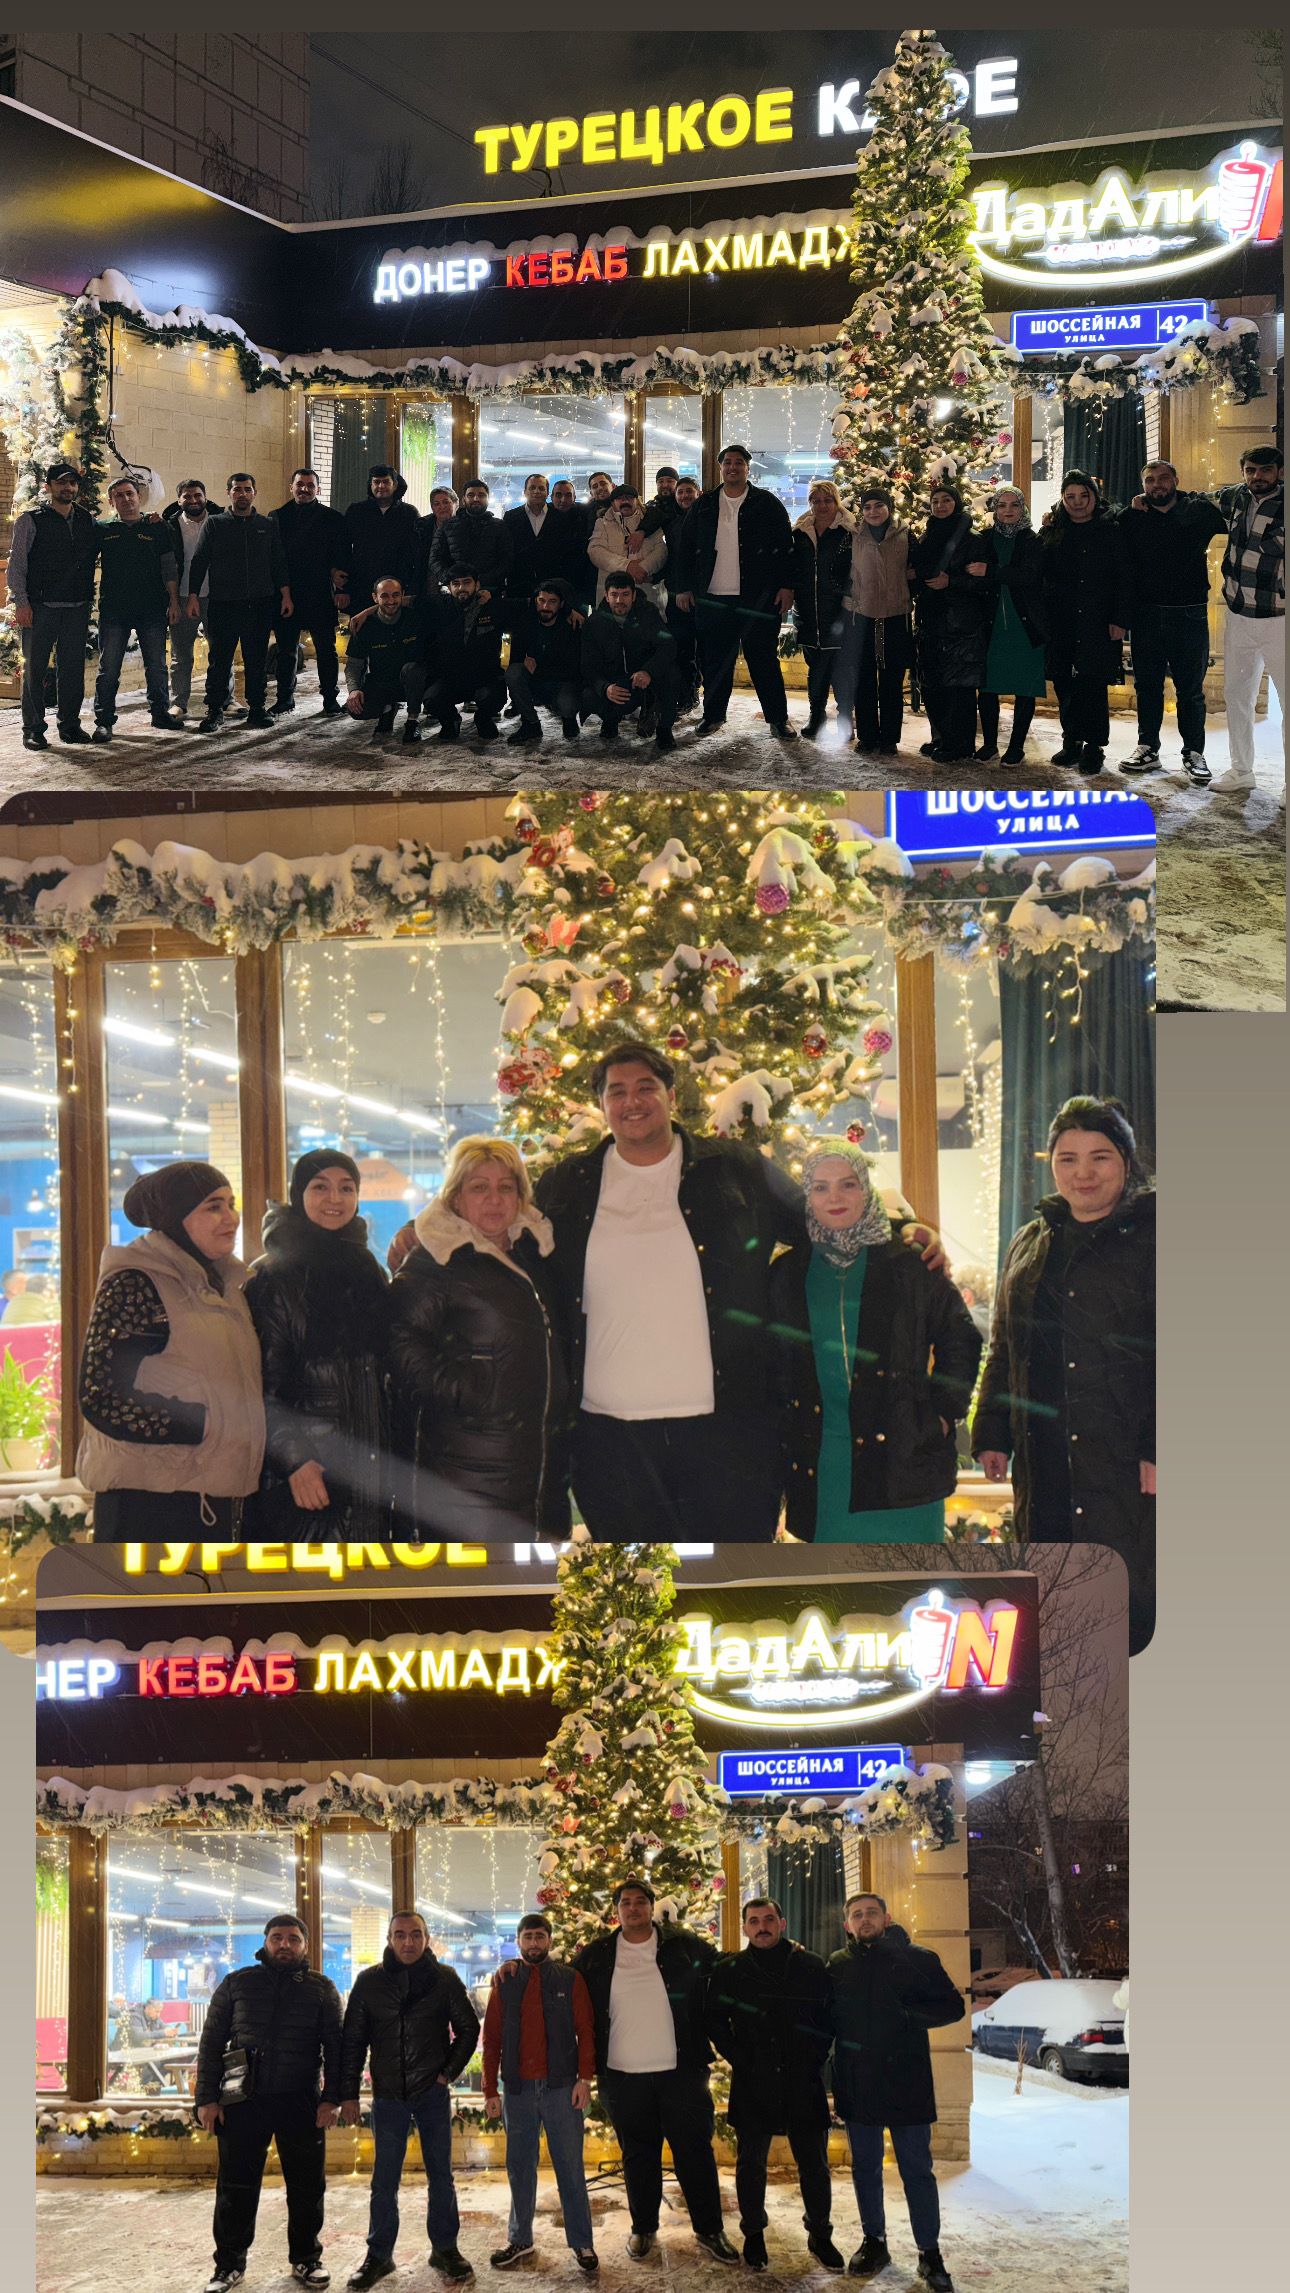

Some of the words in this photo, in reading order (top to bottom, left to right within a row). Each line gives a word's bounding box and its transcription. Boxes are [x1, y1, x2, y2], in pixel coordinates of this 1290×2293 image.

[474, 90, 794, 175] ТУРЕЦКОЕ
[818, 58, 1019, 137] КЕ
[373, 257, 491, 304] ДОНЕР
[506, 245, 629, 287] КЕБАБ
[1030, 314, 1142, 334] ШОССЕЙНАЯ
[1064, 333, 1106, 343] УЛИЦА
[996, 813, 1080, 834] УЛИЦА
[138, 1653, 296, 1696] КЕБАБ
[737, 1756, 844, 1776] ШОССЕЙНАЯ
[770, 1776, 811, 1786] УЛИЦА
